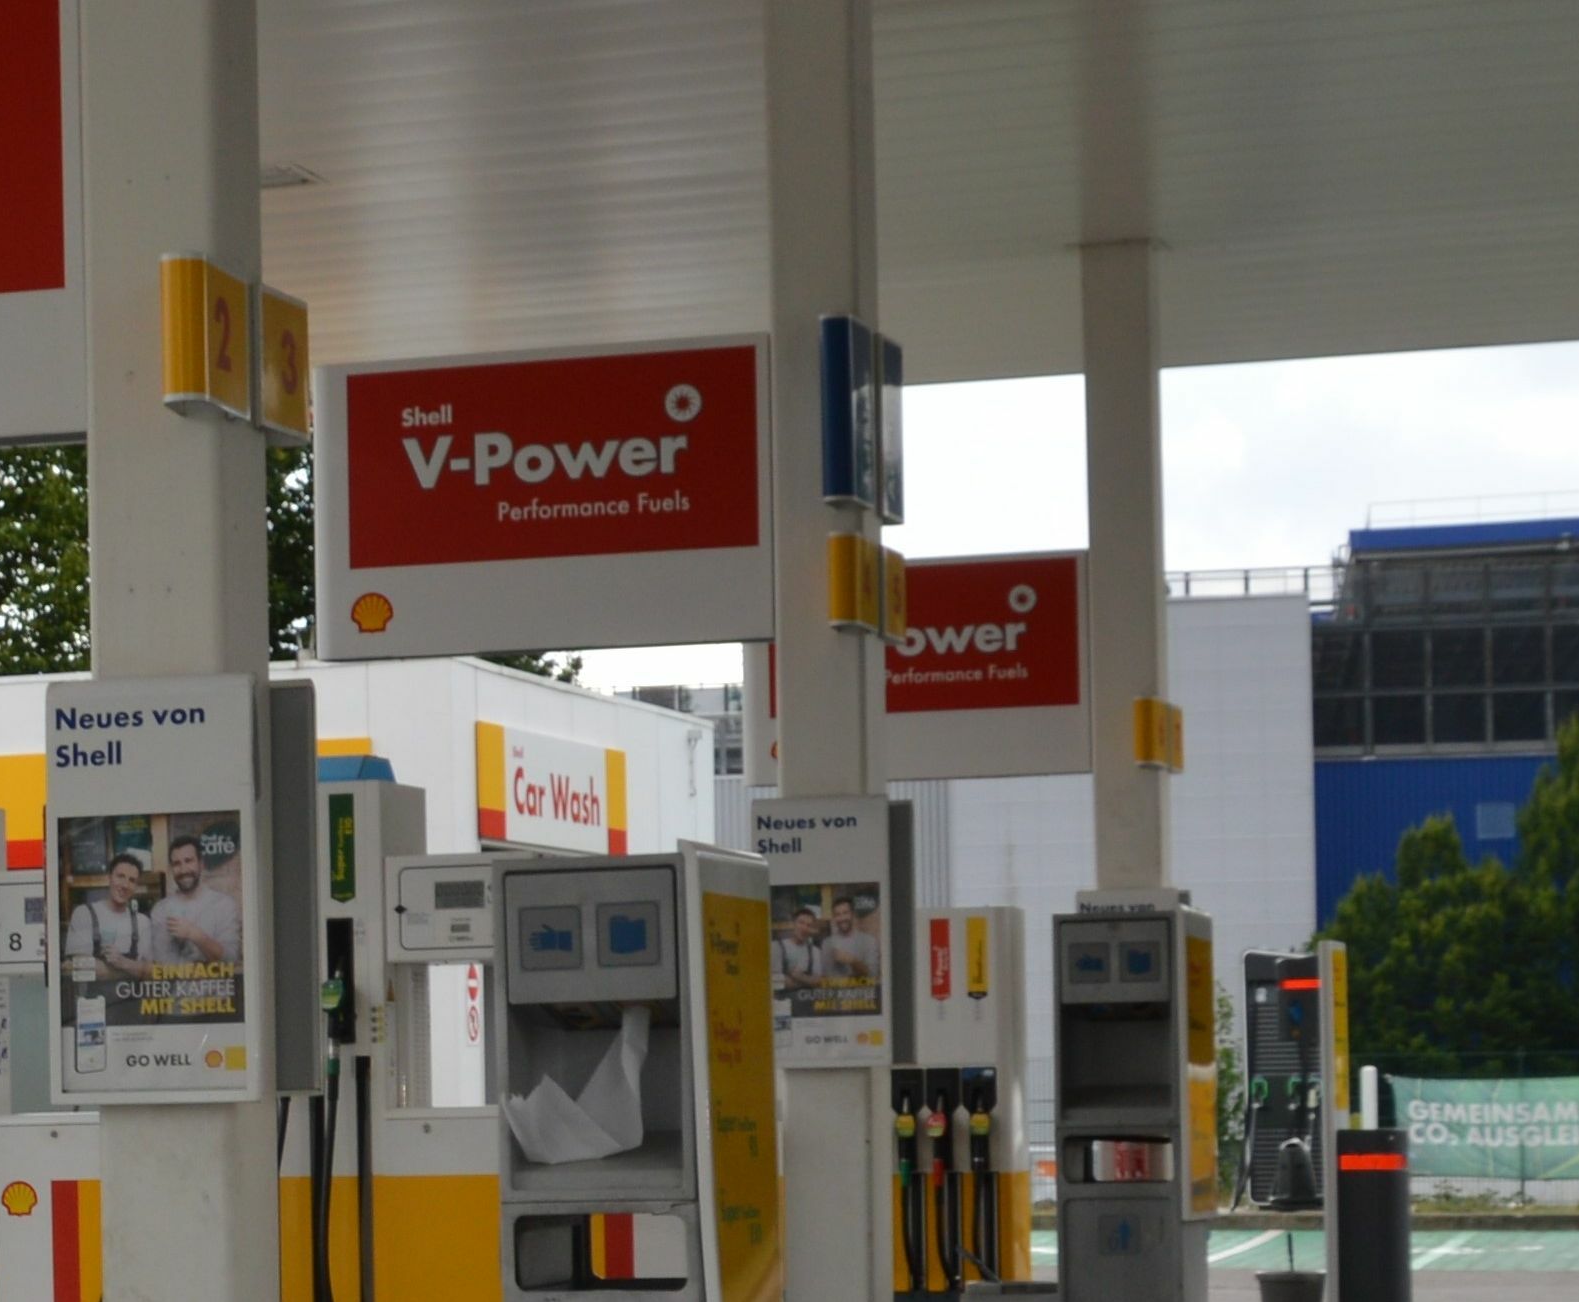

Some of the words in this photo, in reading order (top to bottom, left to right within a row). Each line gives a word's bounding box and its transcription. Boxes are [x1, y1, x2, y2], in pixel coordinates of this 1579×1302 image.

[214, 296, 232, 373] 2
[282, 329, 298, 395] 3
[402, 404, 453, 427] Shell
[402, 431, 689, 490] V-Power
[498, 498, 630, 522] Performance
[638, 490, 690, 513] Fuels
[895, 621, 1026, 657] ower
[988, 663, 1028, 680] Fuels
[55, 707, 143, 731] Neues
[152, 707, 206, 725] von
[56, 739, 122, 768] Shell
[514, 766, 546, 818] Car
[550, 771, 600, 827] Wash
[756, 815, 817, 831] Neues
[821, 815, 857, 829] von
[757, 837, 802, 854] Shell
[8, 934, 22, 953] 8
[153, 961, 235, 980] EINFACH
[115, 981, 171, 999] GUTER
[175, 979, 236, 997] KAFFEE
[140, 998, 175, 1015] MIT
[180, 996, 236, 1014] SHELL
[125, 1054, 150, 1068] GO
[153, 1053, 192, 1067] WELL
[1407, 1099, 1579, 1124] GEMEINSAM
